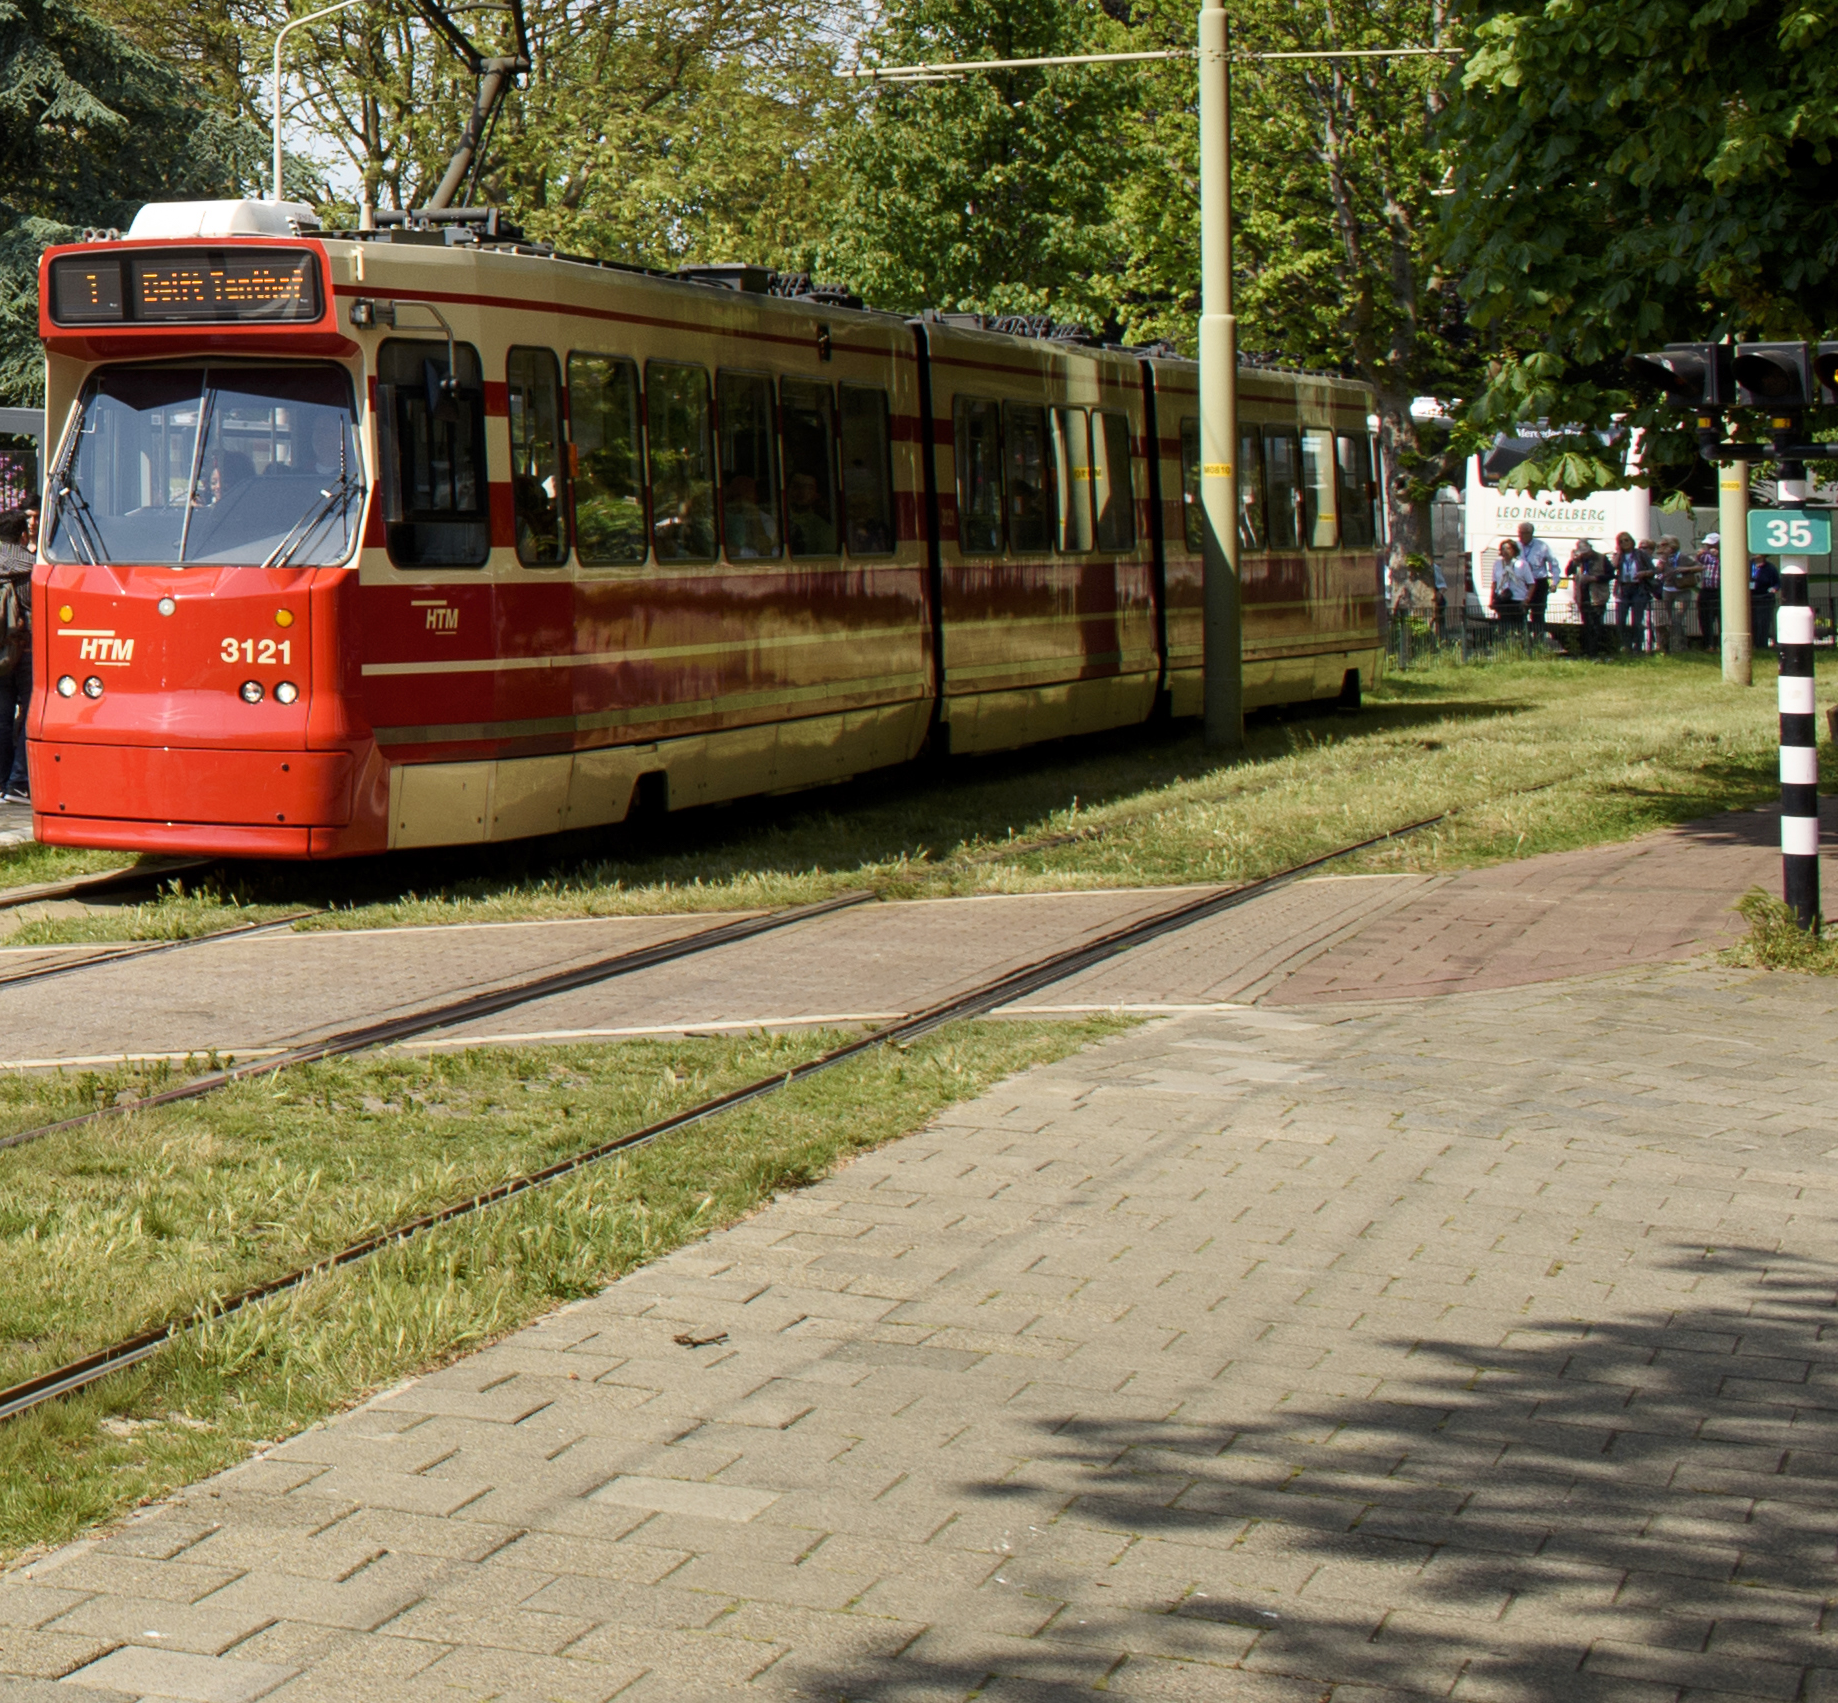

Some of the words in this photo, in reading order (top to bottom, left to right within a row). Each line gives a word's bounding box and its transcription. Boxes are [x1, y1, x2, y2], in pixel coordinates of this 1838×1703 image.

[86, 275, 98, 303] 1
[142, 272, 204, 302] Delft
[1496, 507, 1520, 518] LEO
[1524, 507, 1605, 521] RINGELBERG
[1496, 523, 1605, 532] TOINGCARS
[1766, 519, 1812, 548] 35
[425, 608, 459, 629] HTM
[80, 638, 134, 660] HTM
[220, 637, 291, 664] 3121
